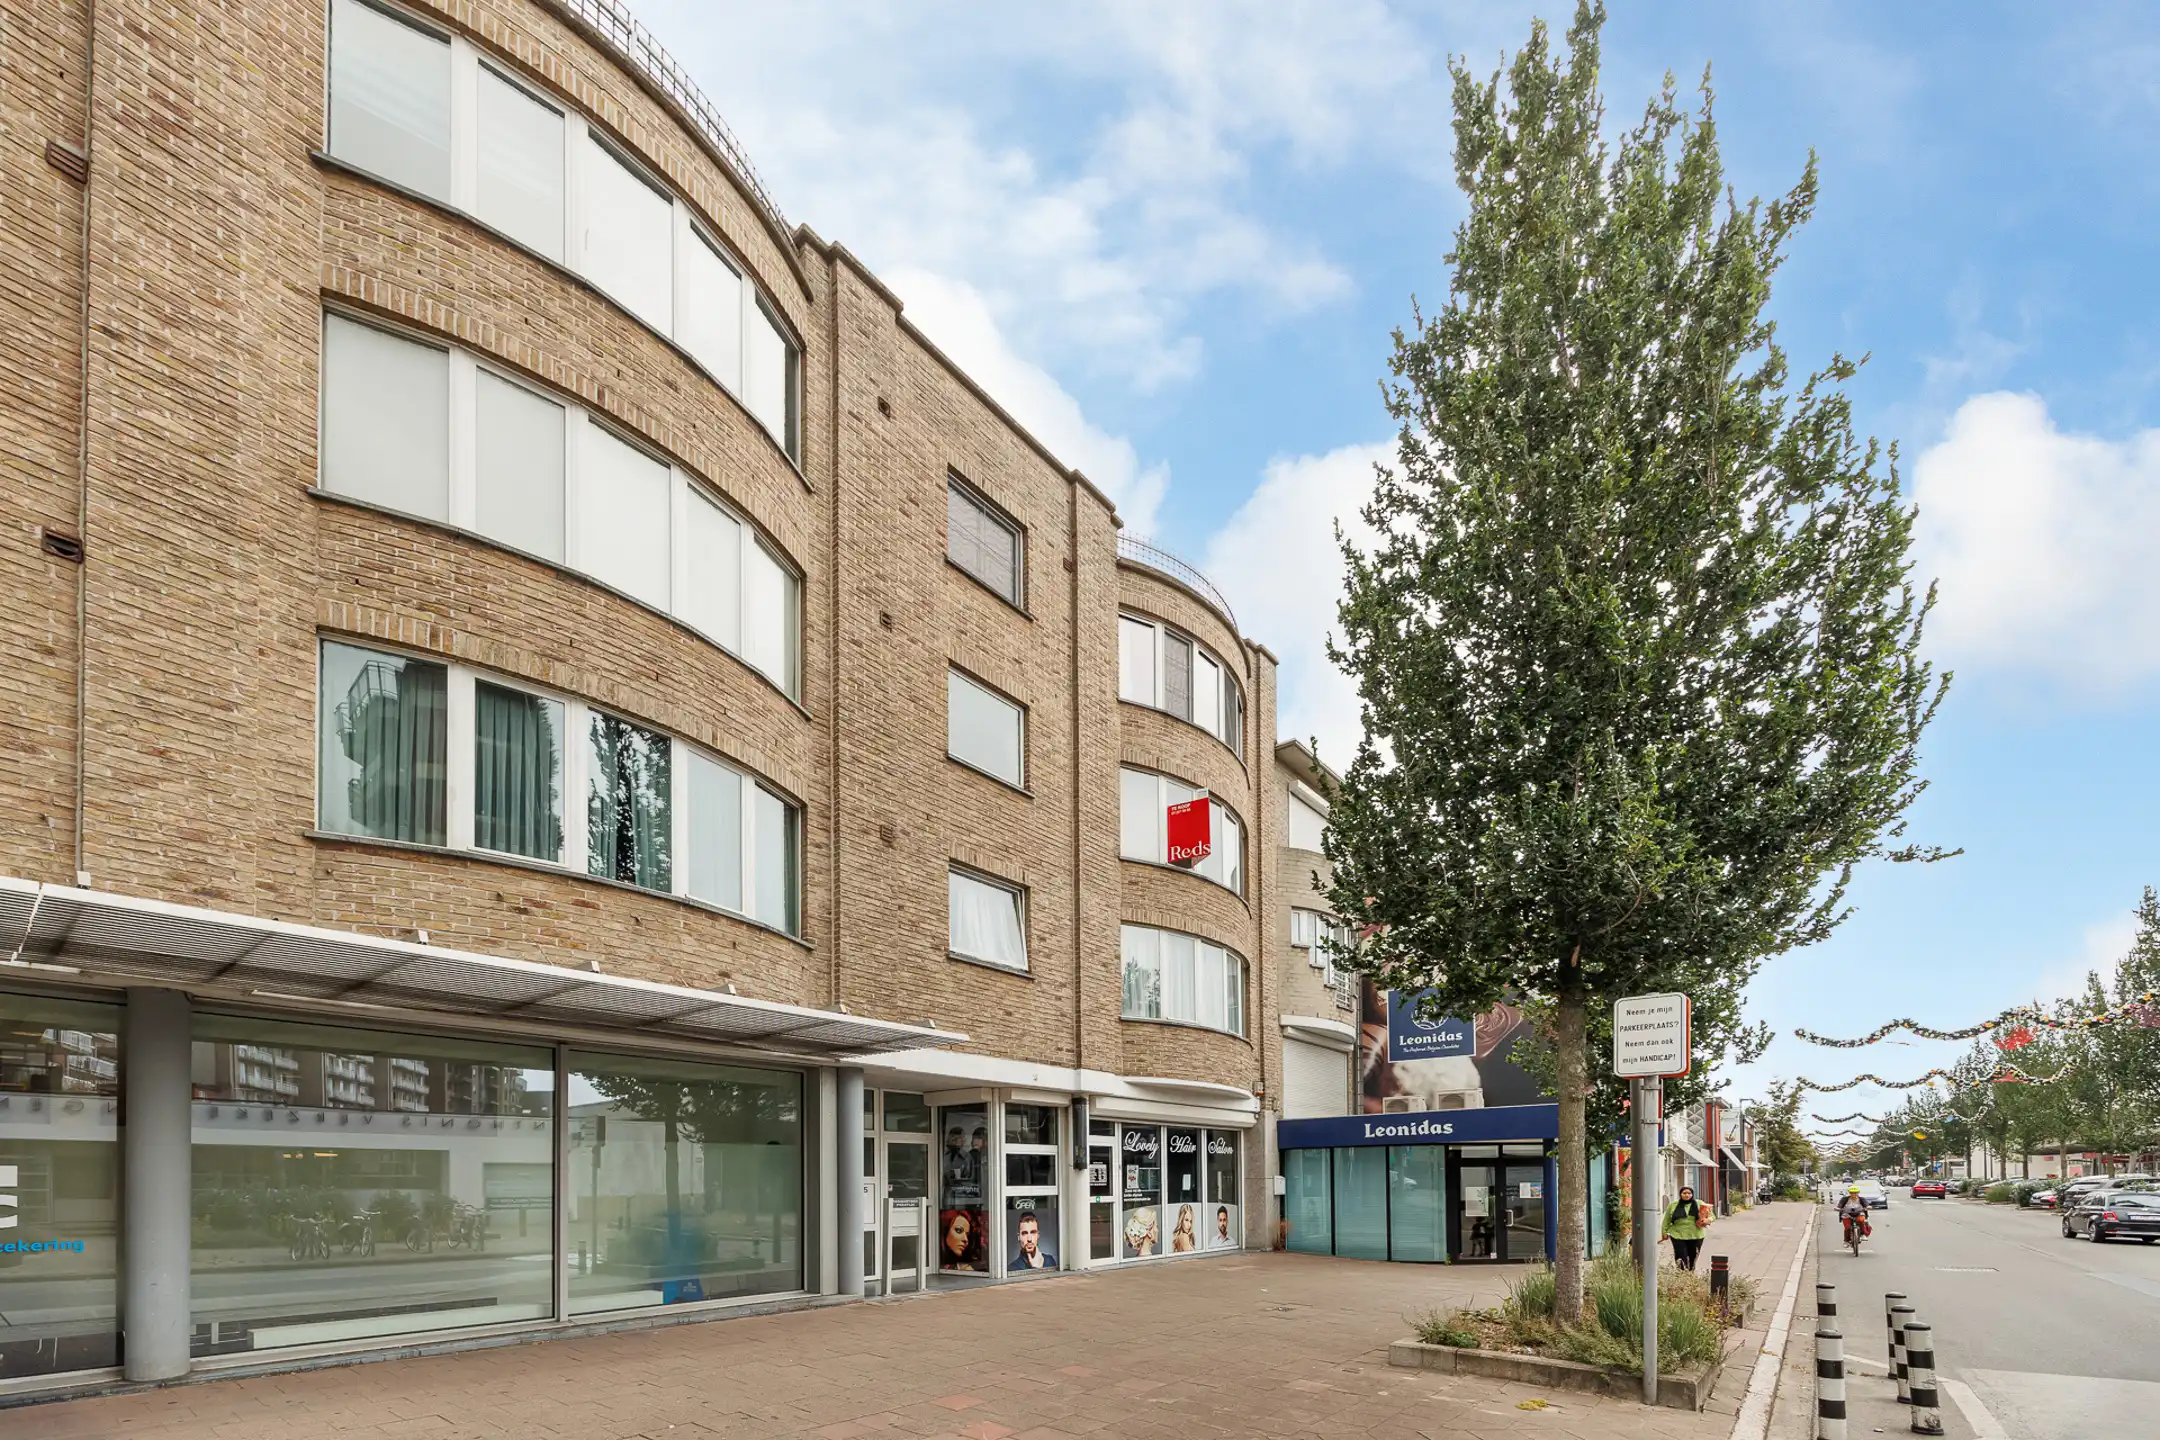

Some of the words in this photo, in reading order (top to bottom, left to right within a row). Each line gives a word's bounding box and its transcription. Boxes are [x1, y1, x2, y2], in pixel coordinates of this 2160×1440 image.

[1170, 840, 1211, 861] Reds
[1626, 1008, 1646, 1016] Neem
[1648, 1007, 1655, 1016] je
[1656, 1005, 1673, 1014] mijn
[1619, 1020, 1680, 1033] PARKEERPLAATS?
[1399, 1031, 1463, 1046] Leonidas
[1625, 1040, 1645, 1048] Neem
[1661, 1037, 1674, 1045] ook
[1622, 1057, 1638, 1065] mijn
[1639, 1053, 1676, 1063] HANDICAP!
[1364, 1119, 1454, 1138] Leonidas
[1123, 1131, 1160, 1160] Lovely
[1169, 1135, 1197, 1153] Hair
[1207, 1136, 1234, 1155] Salon
